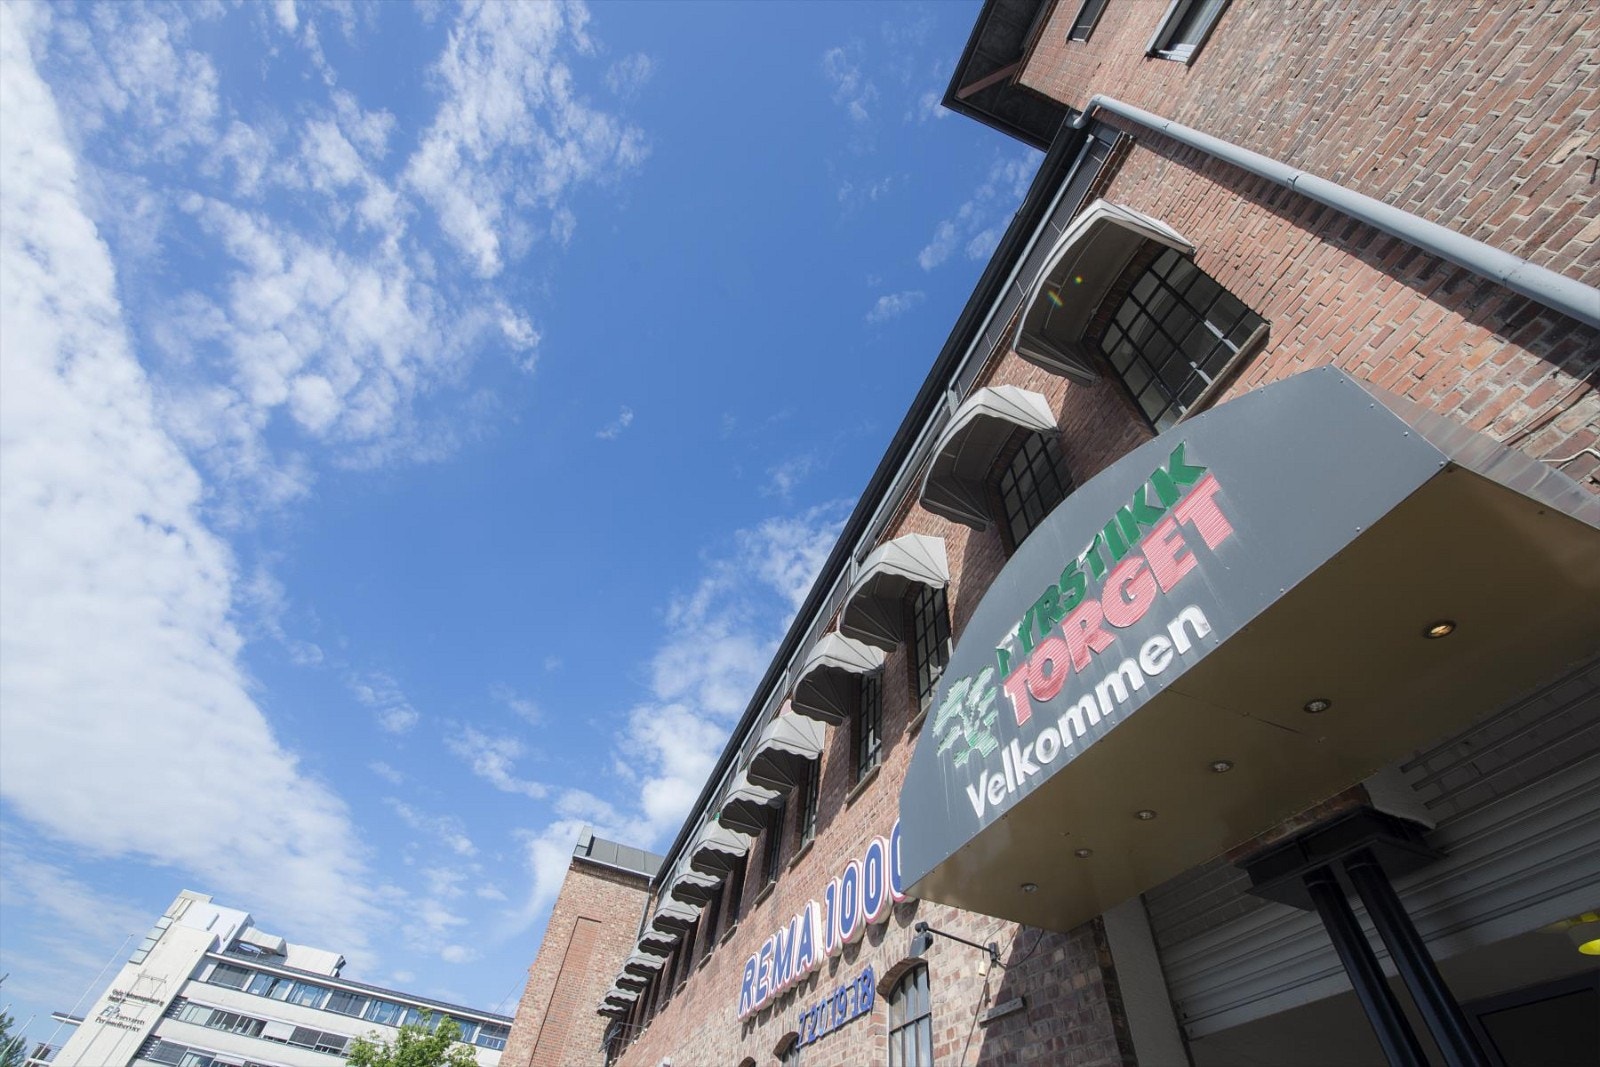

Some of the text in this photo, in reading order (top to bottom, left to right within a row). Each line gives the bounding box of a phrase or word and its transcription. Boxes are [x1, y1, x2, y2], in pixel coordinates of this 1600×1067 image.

[996, 440, 1208, 678] FYRSTIKK
[1004, 473, 1234, 727] TORGET
[966, 604, 1211, 818] Velkommen
[738, 899, 820, 1021] REMA
